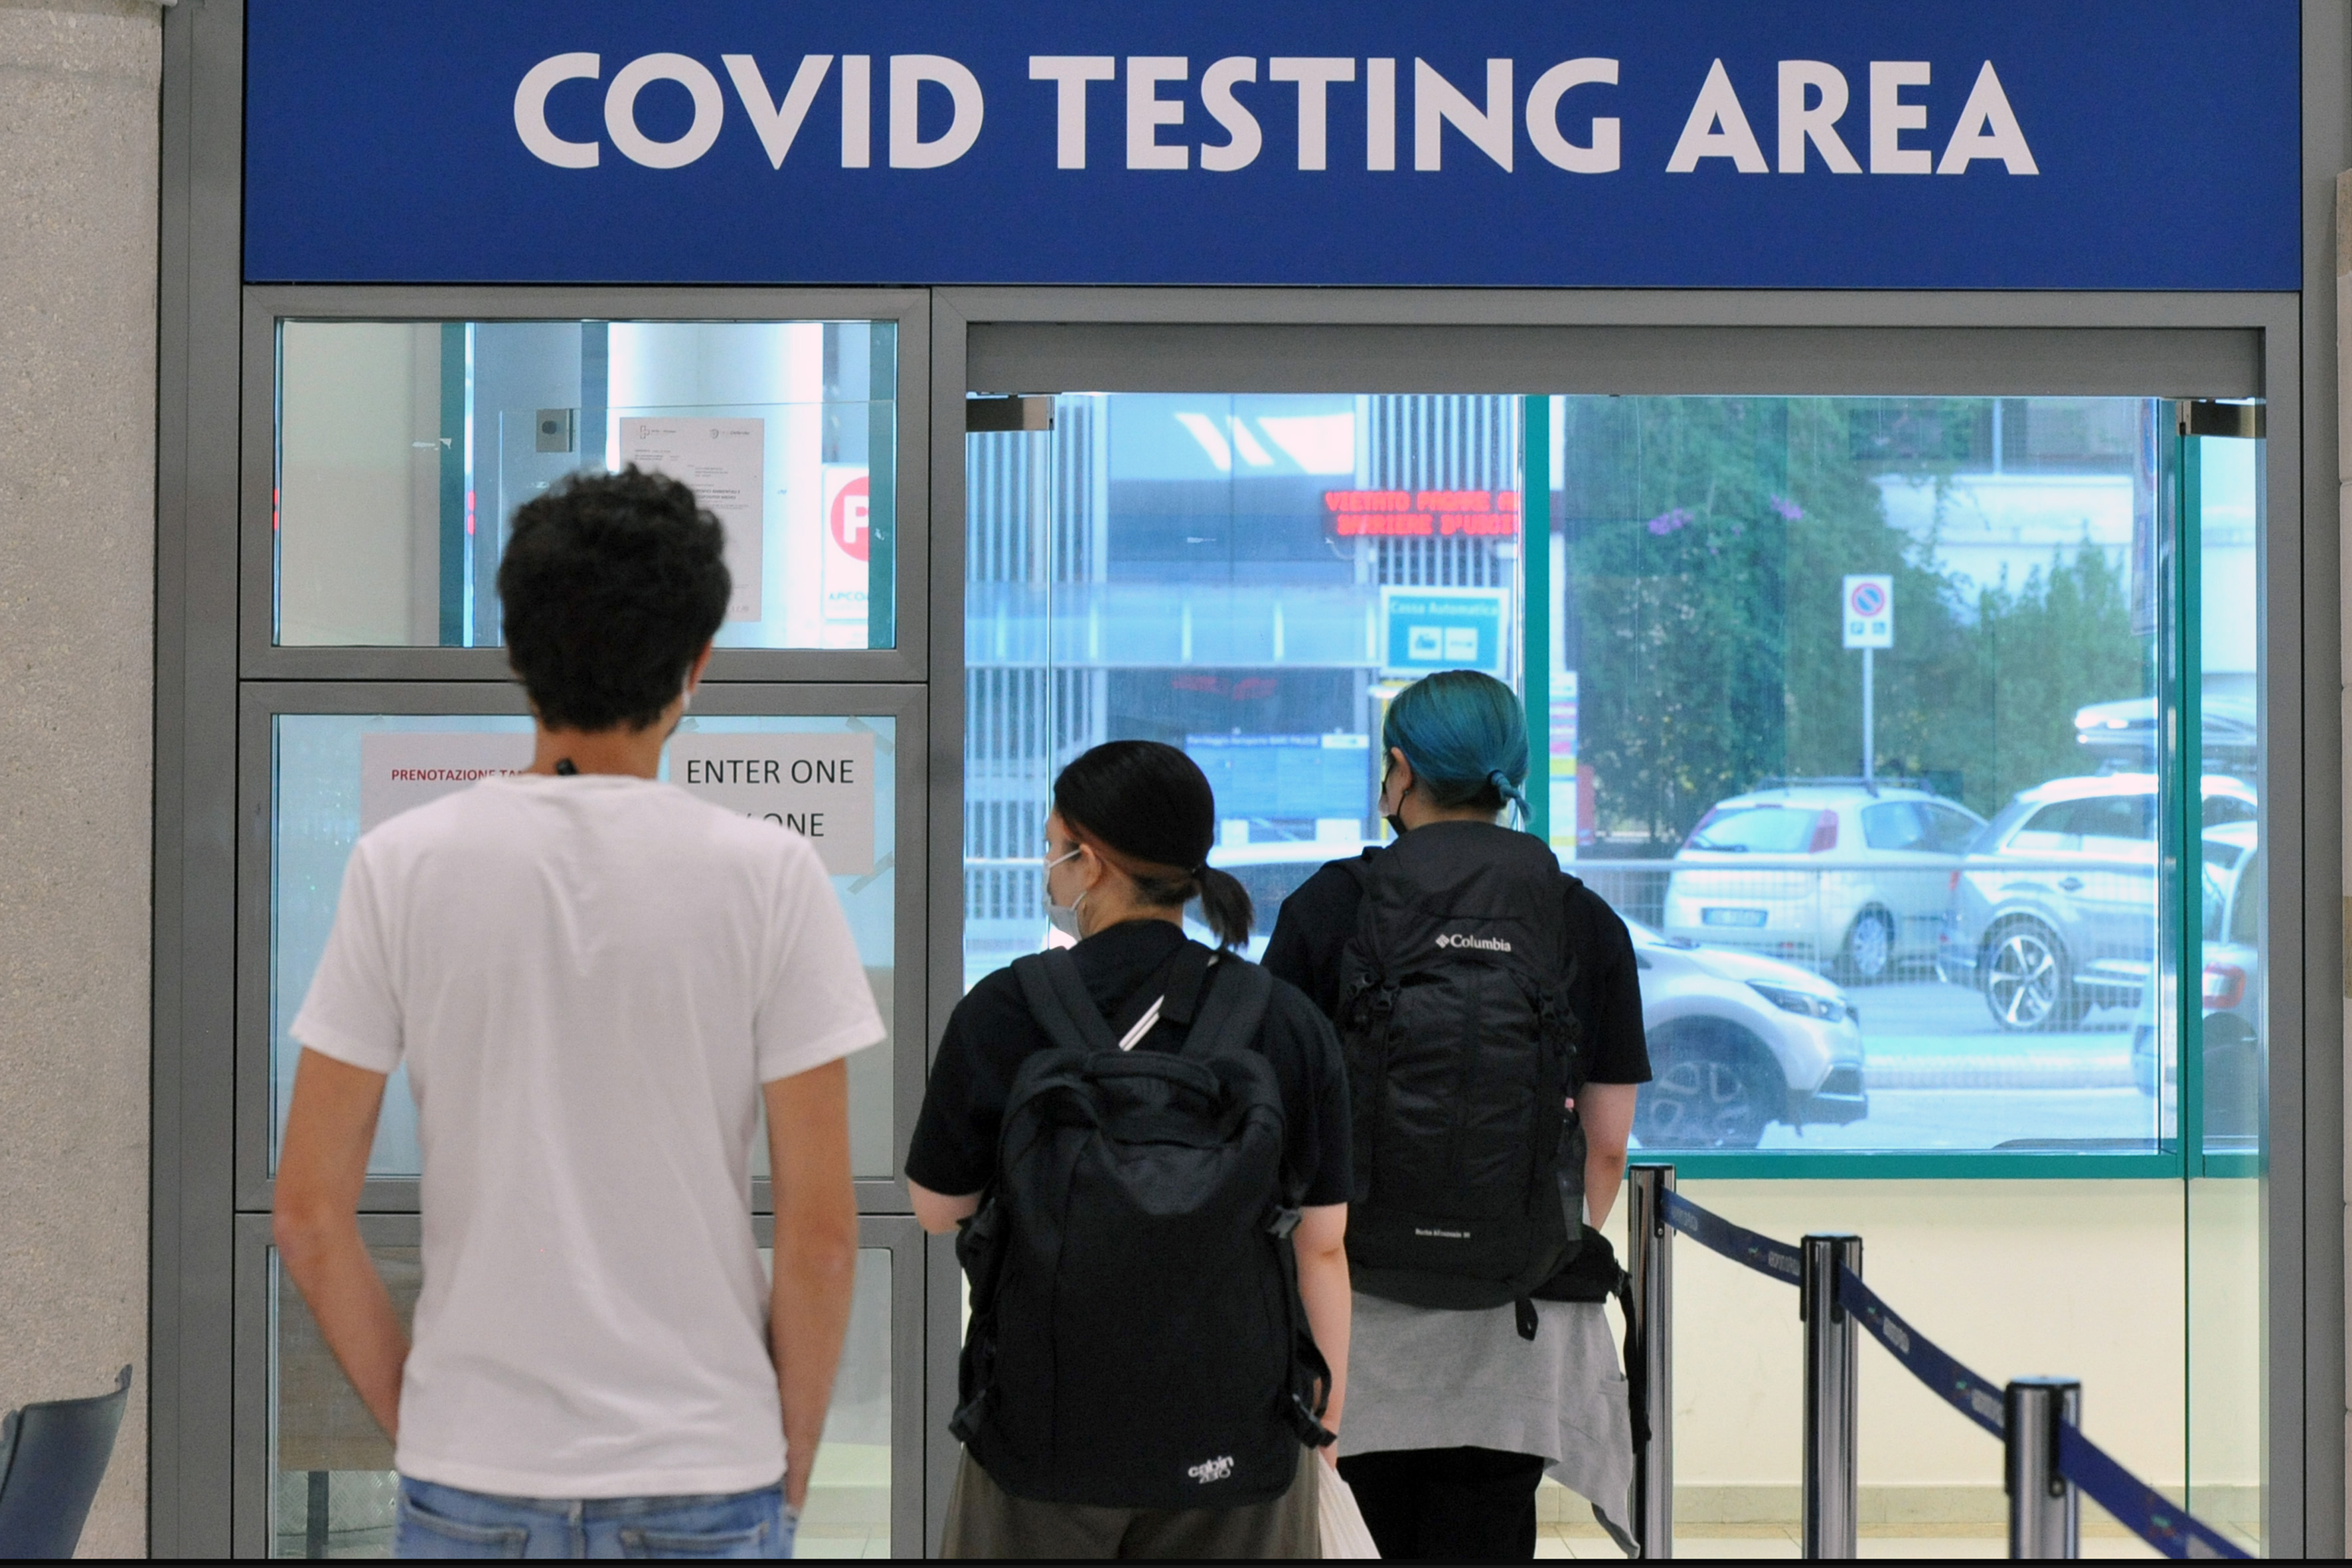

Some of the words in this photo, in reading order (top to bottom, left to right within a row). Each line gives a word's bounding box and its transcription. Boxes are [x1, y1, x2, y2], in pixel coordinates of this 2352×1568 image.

[514, 51, 984, 170] COVID
[1028, 55, 1620, 174] TESTING
[1665, 58, 2040, 176] AREA
[391, 769, 495, 781] PRENOTAZIONE
[688, 759, 781, 784] ENTER
[791, 759, 854, 784] ONE
[1450, 933, 1512, 952] Columbia
[1188, 1454, 1235, 1478] cabin
